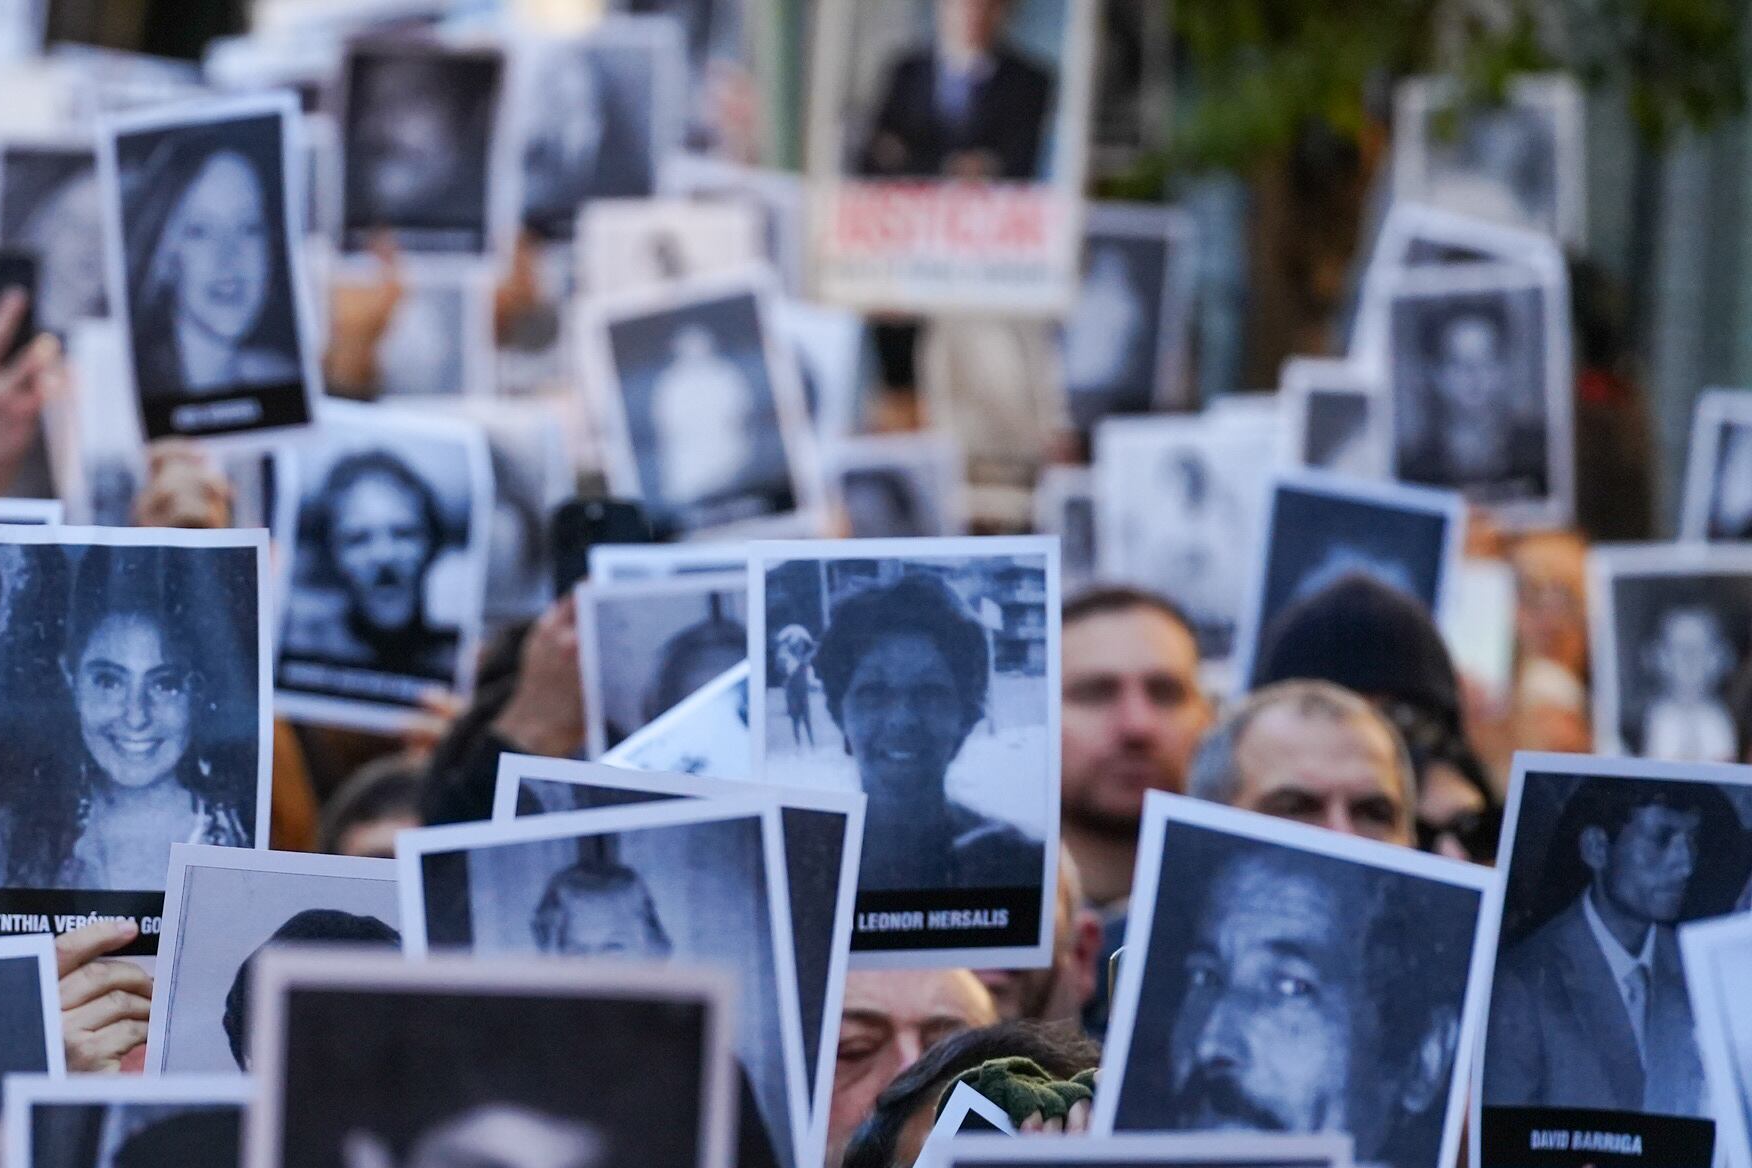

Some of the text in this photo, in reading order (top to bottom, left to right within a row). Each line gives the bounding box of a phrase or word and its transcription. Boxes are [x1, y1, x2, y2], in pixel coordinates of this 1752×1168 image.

[857, 908, 1009, 932] LEONOR HERSALIS
[1530, 1129, 1643, 1156] DAVID BARRIGA
